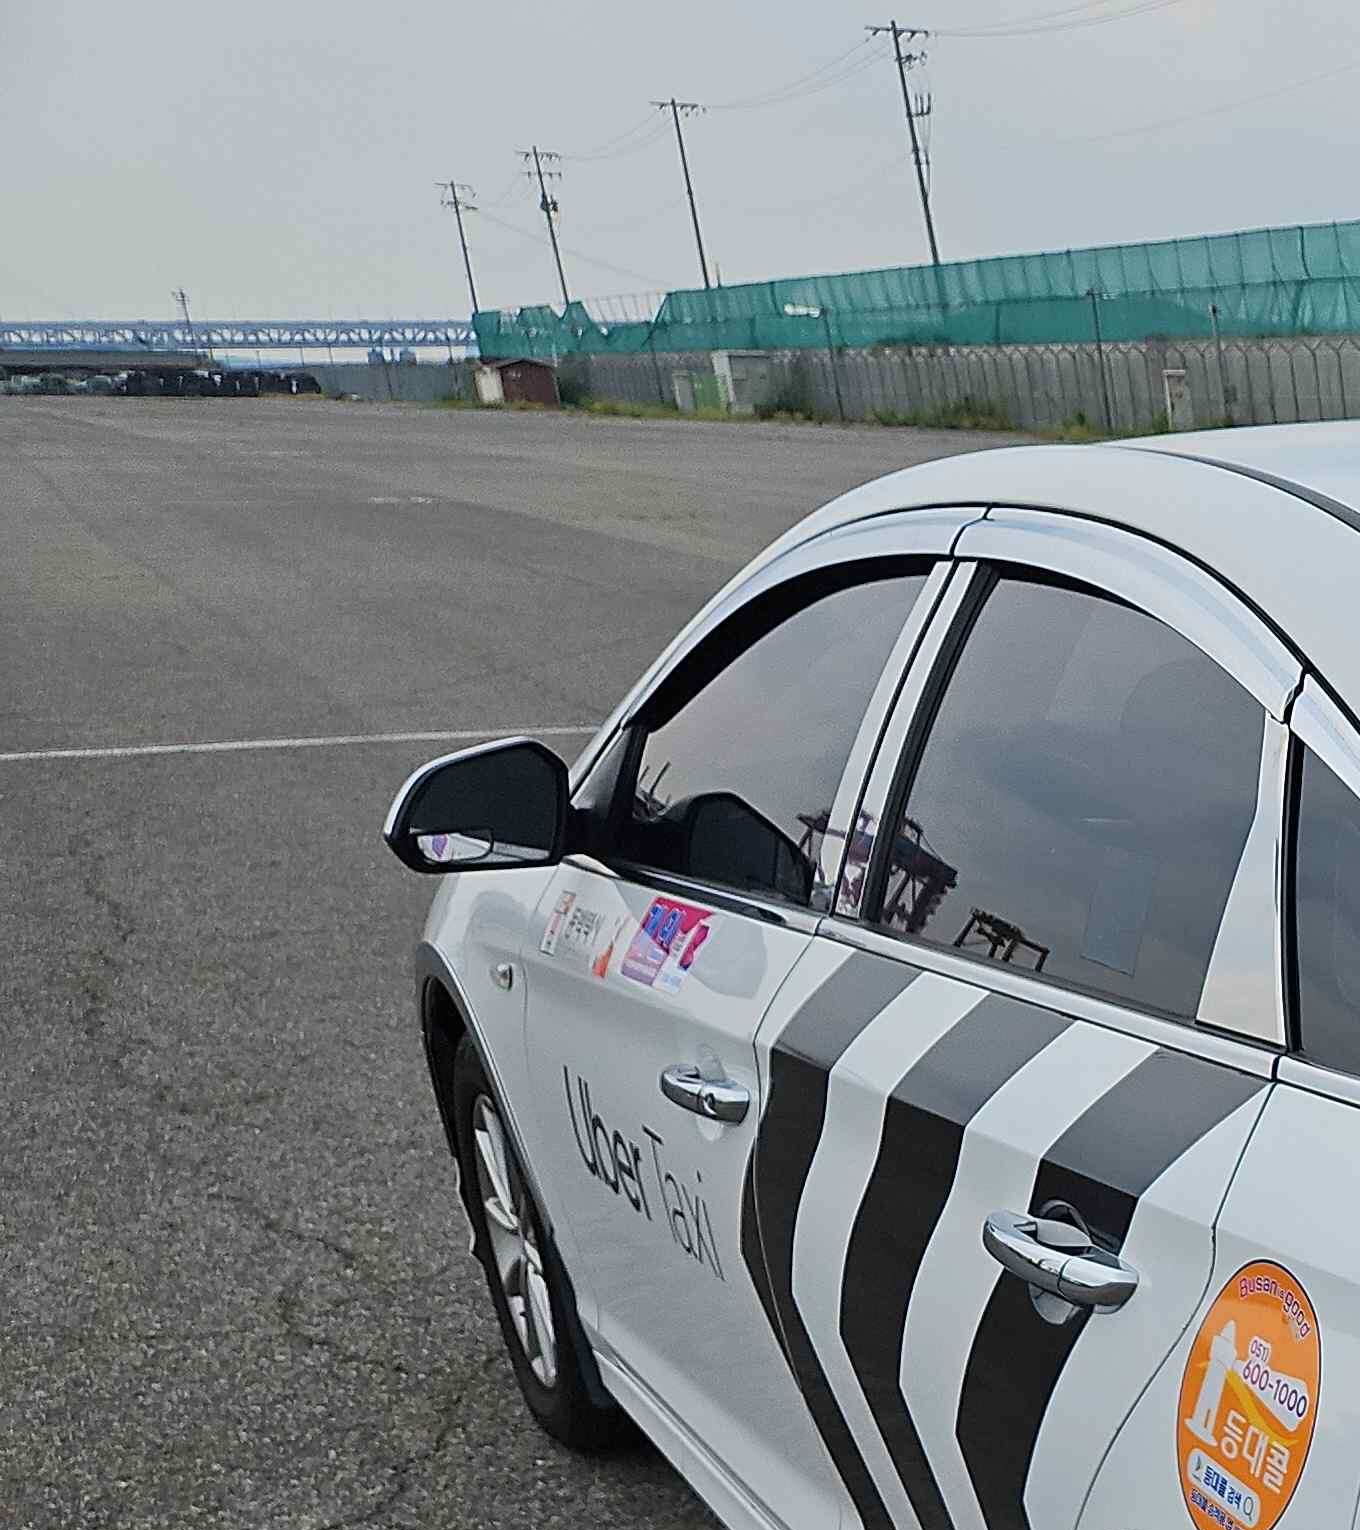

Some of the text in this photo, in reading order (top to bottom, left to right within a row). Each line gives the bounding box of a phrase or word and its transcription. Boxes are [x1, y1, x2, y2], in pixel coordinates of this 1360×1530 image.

[563, 1065, 727, 1282] Uber Taxi
[1239, 1276, 1277, 1298] Busan
[1284, 1291, 1311, 1338] good
[1242, 1361, 1308, 1418] 600-1000
[1221, 1409, 1290, 1495] 등대콜
